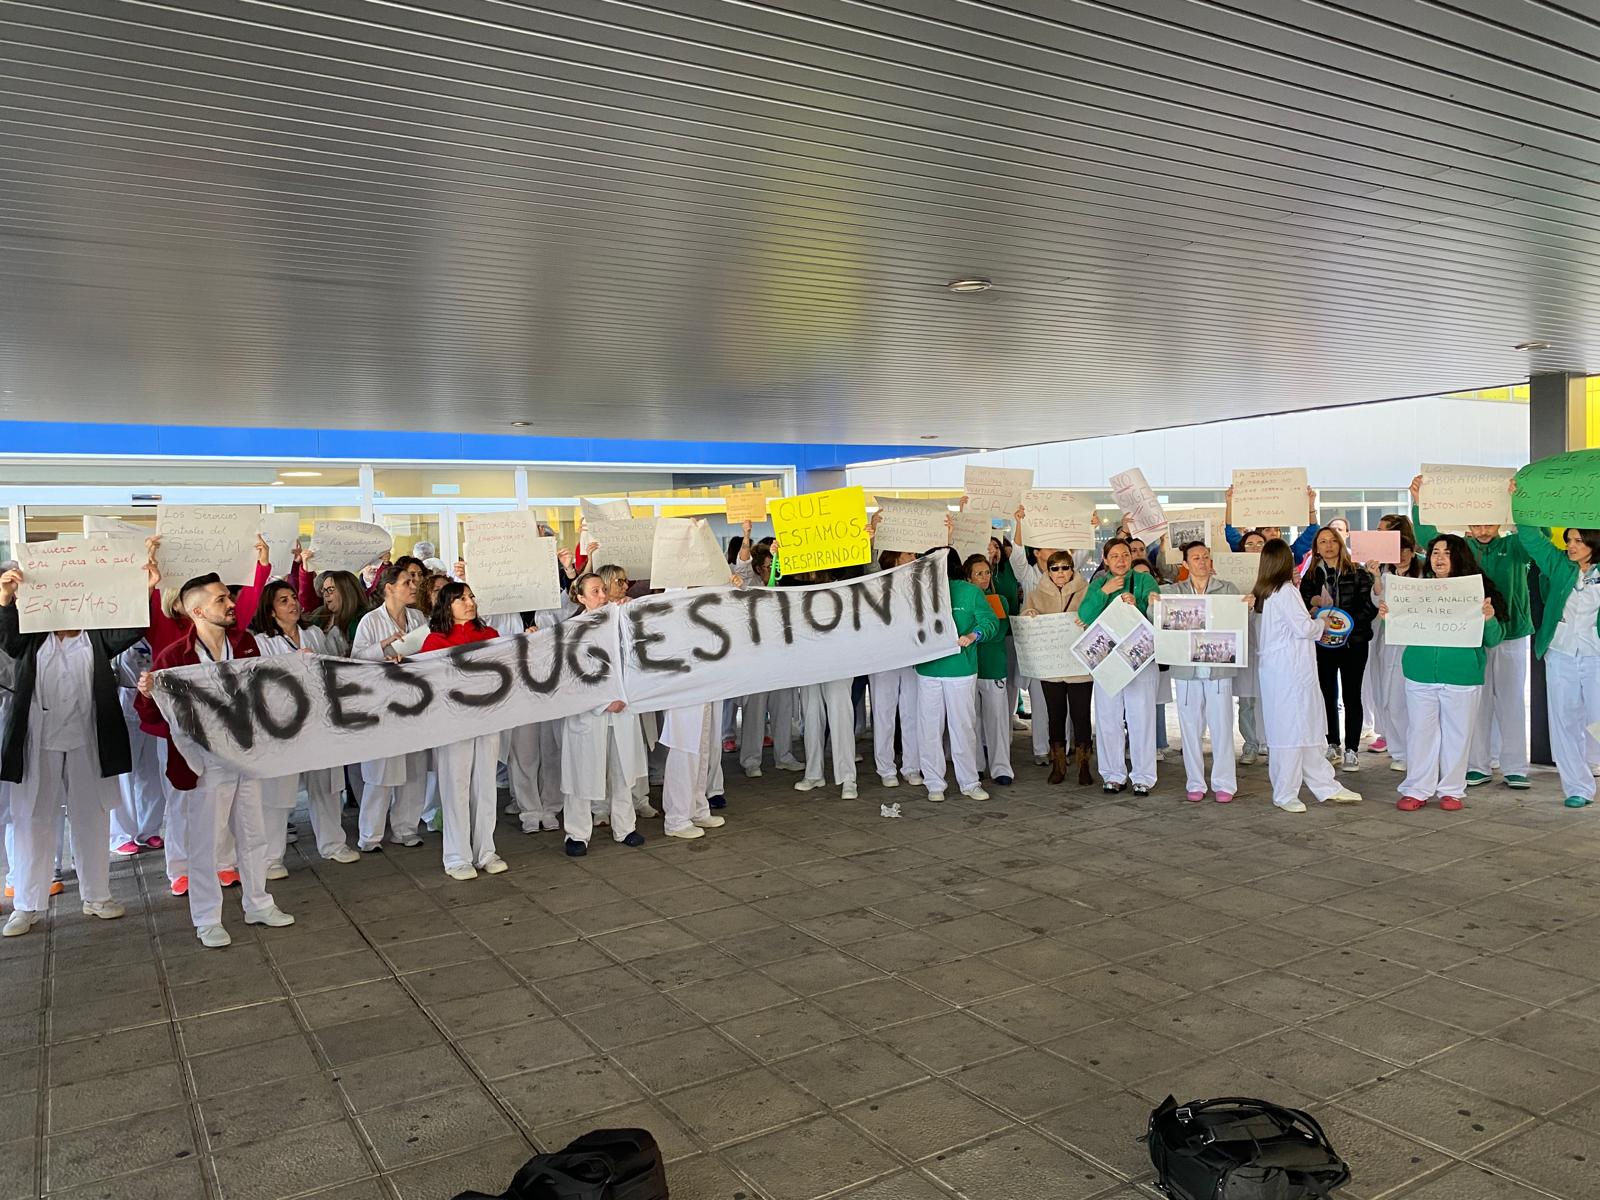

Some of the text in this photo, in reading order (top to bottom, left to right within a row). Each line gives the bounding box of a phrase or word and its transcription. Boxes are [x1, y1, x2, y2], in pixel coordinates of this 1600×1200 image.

[1424, 465, 1453, 473] LOS
[1543, 467, 1579, 480] EPI
[1025, 492, 1077, 502] ESTO ES
[779, 495, 832, 521] QUE
[1026, 504, 1049, 513] UNA
[1421, 500, 1494, 511] INTOXICADOS
[164, 507, 238, 520] Los Servicios
[1242, 507, 1252, 517] 2
[778, 517, 862, 548] ESTAMOS
[168, 537, 240, 554] SESCAM
[783, 537, 869, 572] RESPIRANDO?
[1390, 582, 1450, 592] QUEREMOS
[24, 592, 119, 615] ERITEMAS
[1393, 595, 1412, 603] QUE
[1437, 595, 1480, 603] ANALICE
[1426, 607, 1454, 615] AIRE
[1412, 622, 1468, 632] AL 100%
[160, 664, 311, 754] NO
[320, 655, 436, 731] ES
